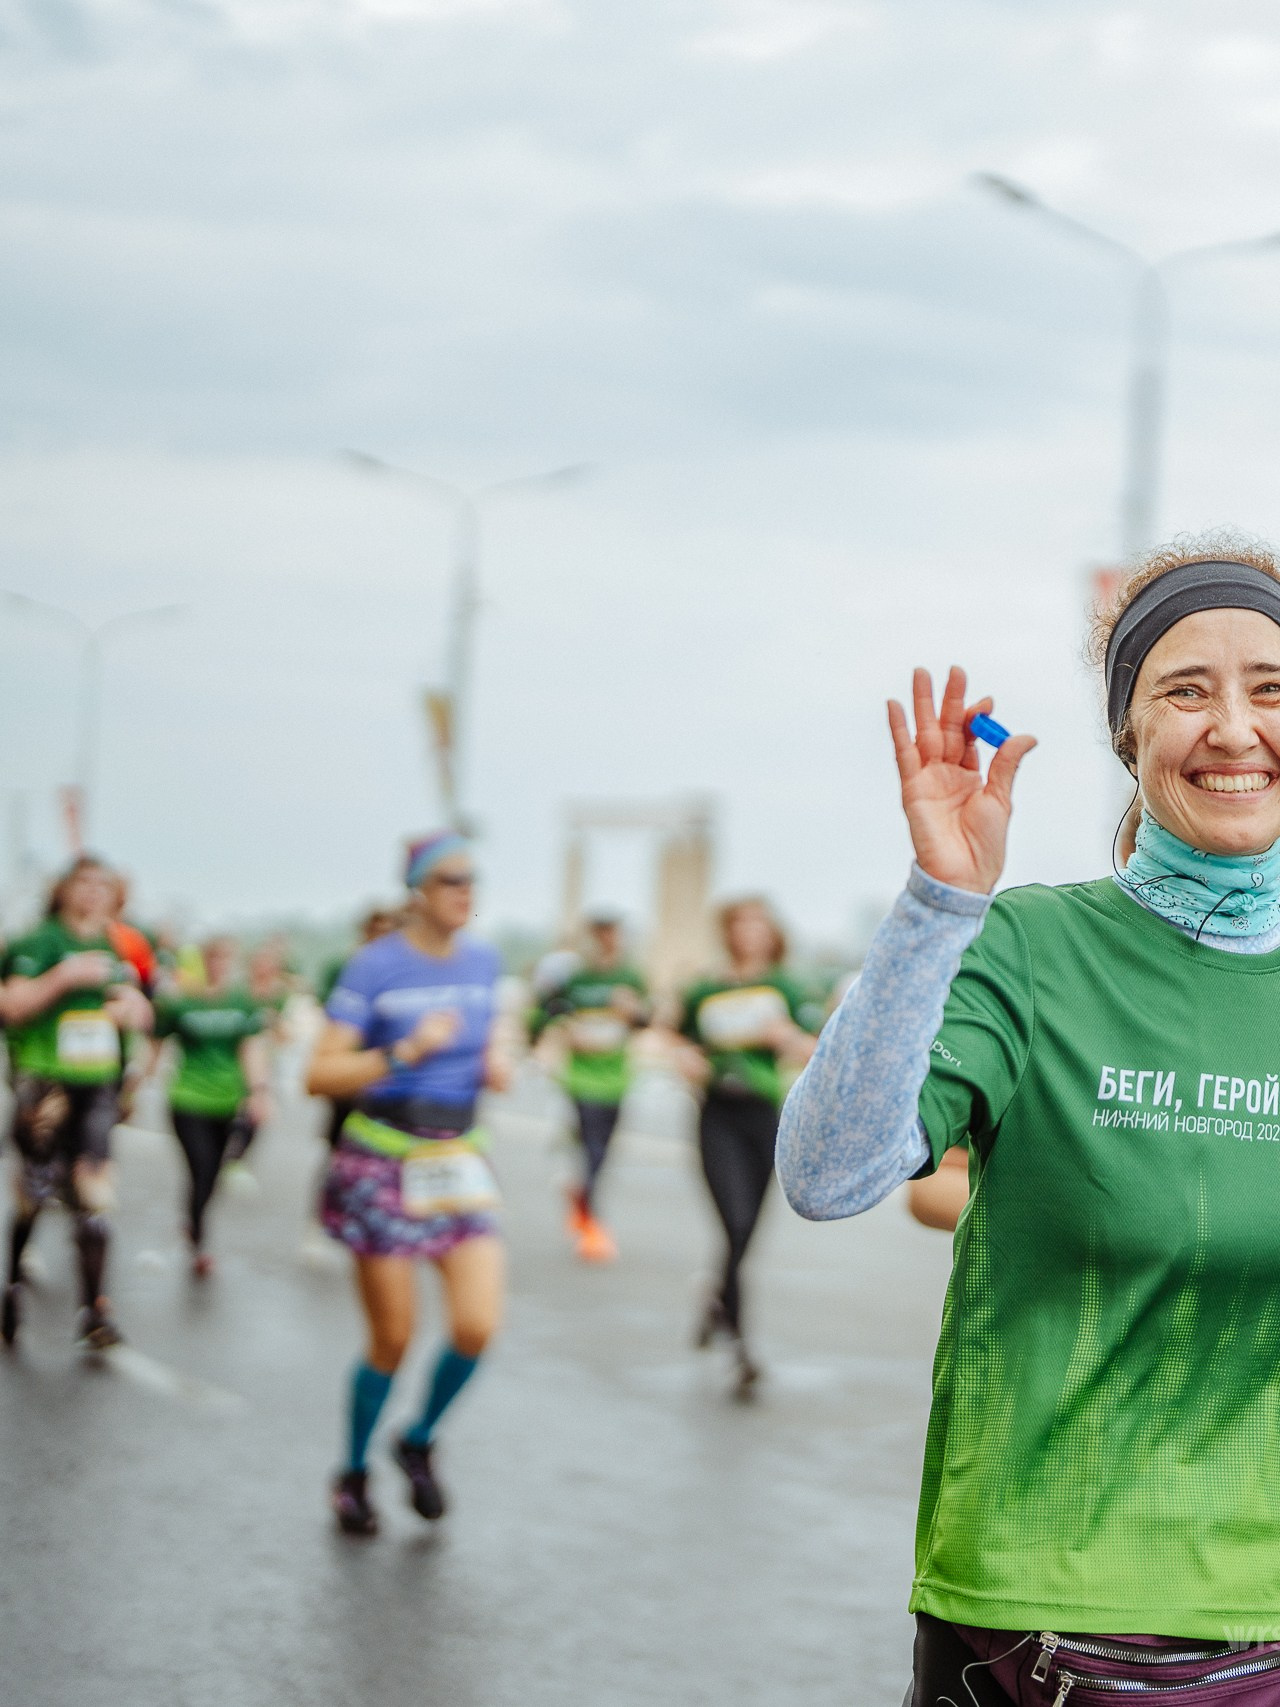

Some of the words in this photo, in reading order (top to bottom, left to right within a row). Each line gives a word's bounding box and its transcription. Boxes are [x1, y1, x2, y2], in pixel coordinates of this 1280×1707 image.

[929, 1037, 962, 1067] port
[1097, 1065, 1183, 1113] БЕГИ,
[1092, 1108, 1170, 1132] НИЖНИЙ
[1174, 1115, 1253, 1142] НОВГОРОД
